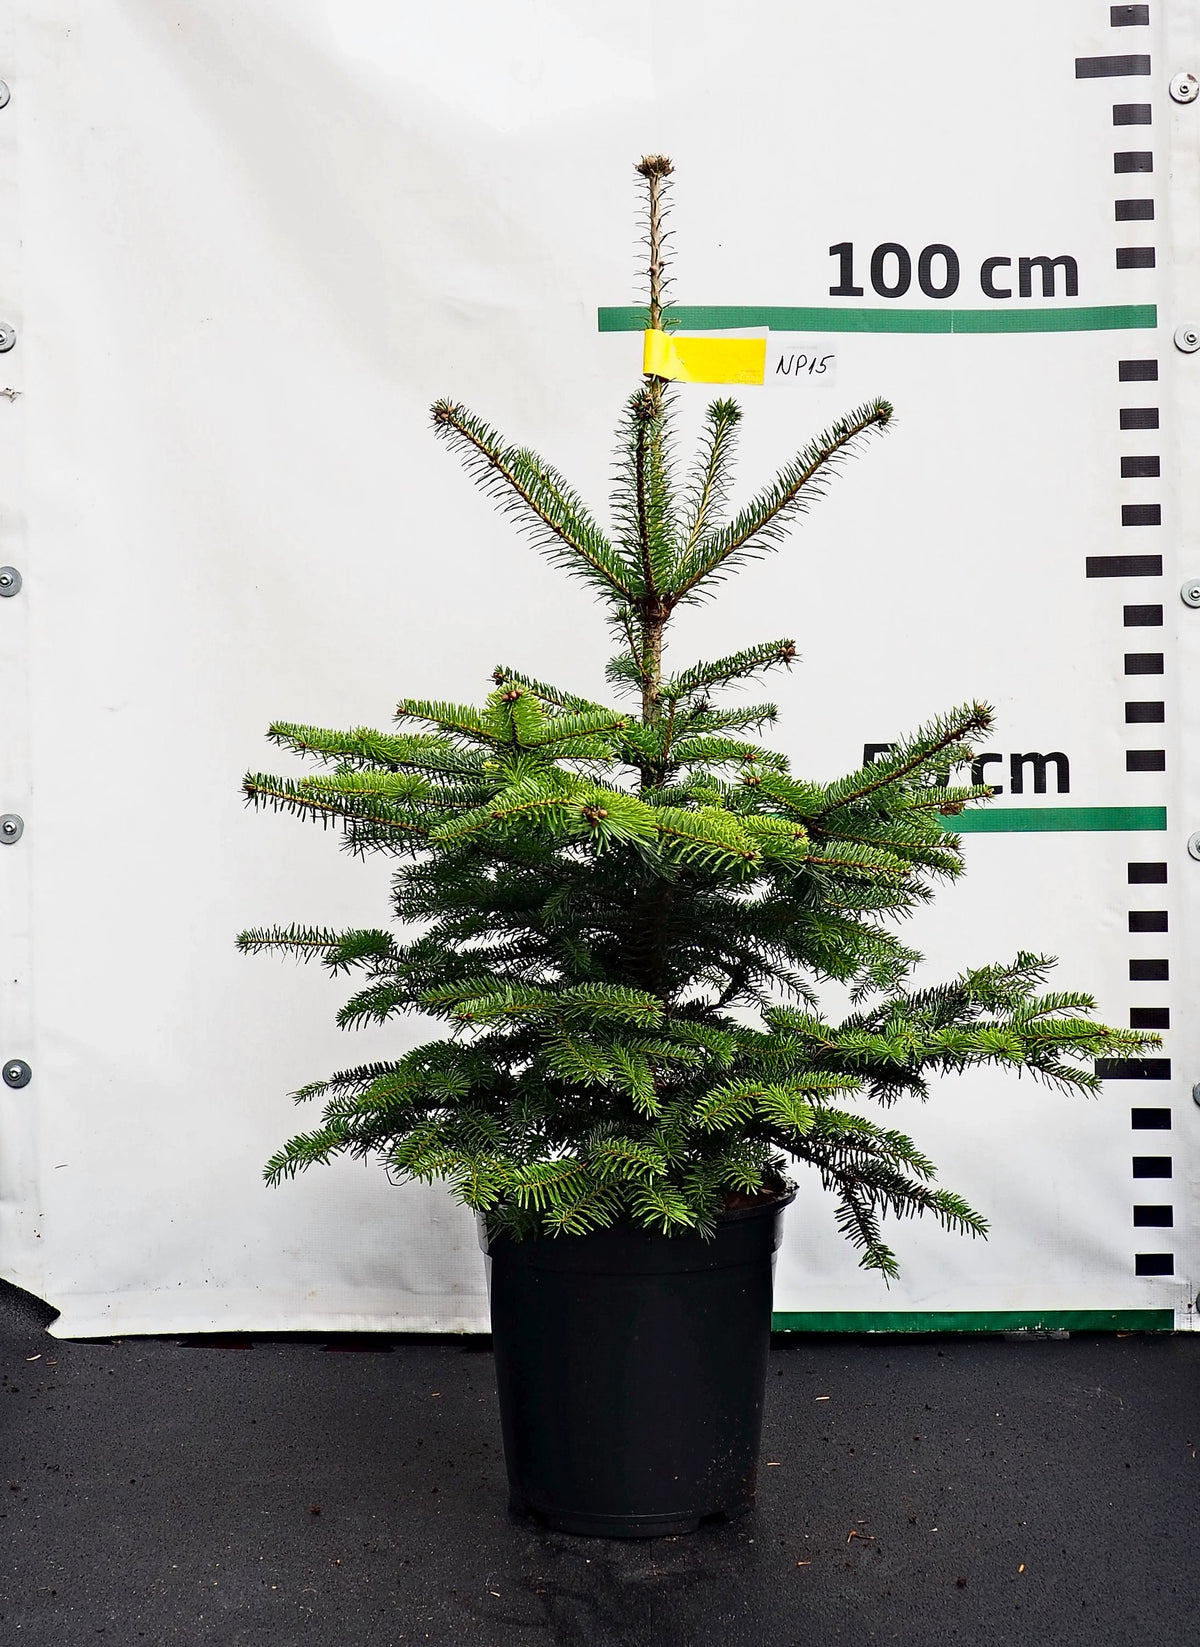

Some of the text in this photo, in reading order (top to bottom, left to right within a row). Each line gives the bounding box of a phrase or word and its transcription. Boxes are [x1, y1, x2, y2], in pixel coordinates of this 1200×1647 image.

[829, 242, 1079, 299] 100 cm
[775, 354, 835, 376] NP15
[970, 751, 1071, 796] cm
